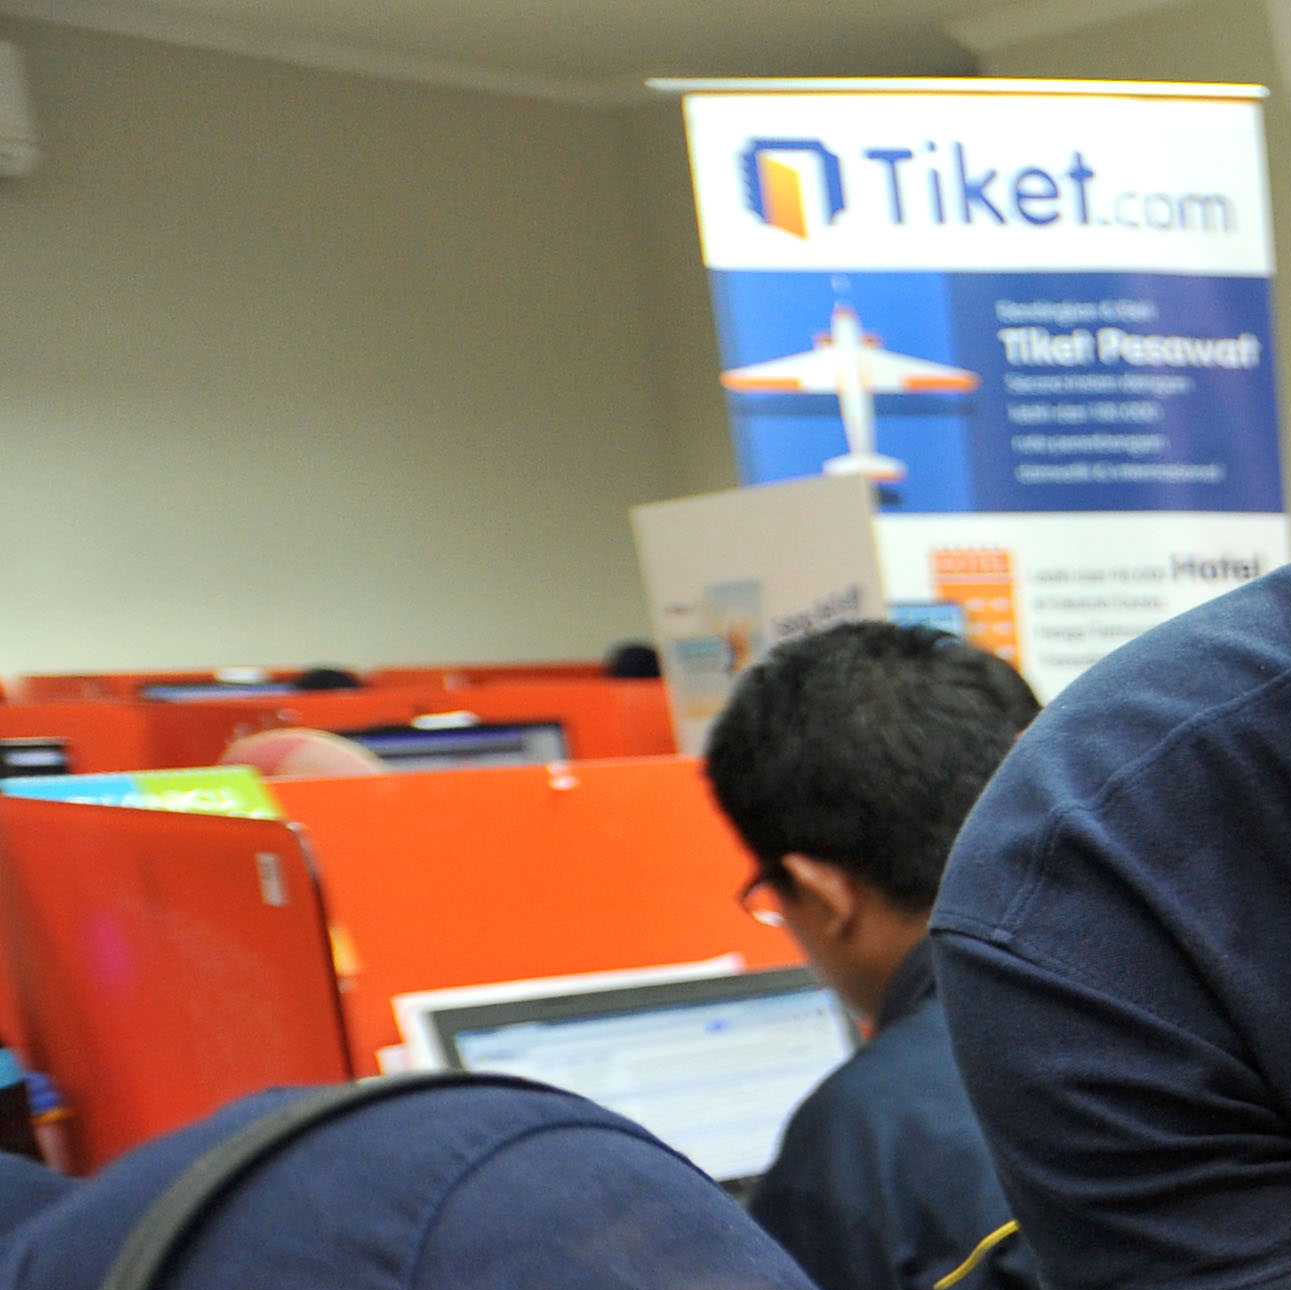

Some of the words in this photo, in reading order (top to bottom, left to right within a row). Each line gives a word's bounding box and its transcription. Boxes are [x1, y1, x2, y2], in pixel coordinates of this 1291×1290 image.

[862, 140, 1238, 234] Tiket.com
[998, 326, 1096, 367] Tiket
[1097, 326, 1262, 370] Pesawat
[1169, 552, 1262, 582] Hotel
